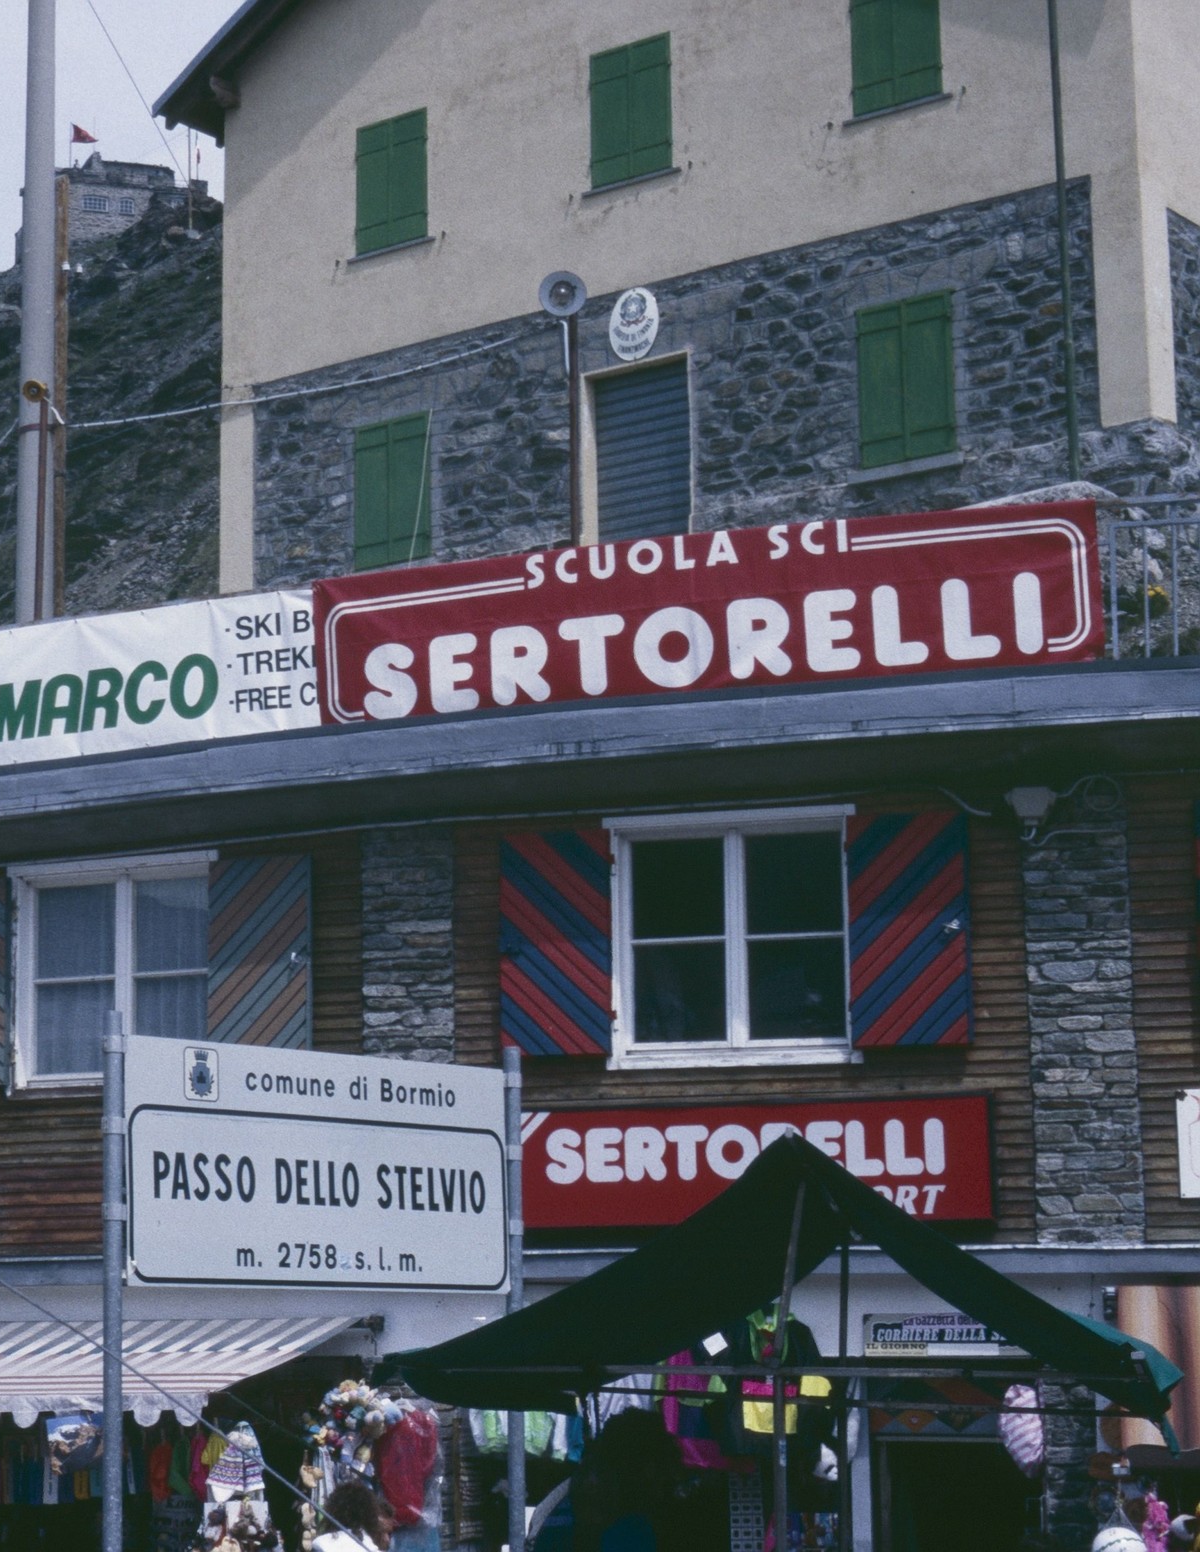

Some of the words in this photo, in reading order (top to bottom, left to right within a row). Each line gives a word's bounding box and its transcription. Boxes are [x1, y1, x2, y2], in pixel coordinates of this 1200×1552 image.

[525, 531, 739, 590] SCUOLA
[768, 519, 848, 556] SCI
[235, 612, 282, 640] SKI
[293, 609, 313, 634] B
[236, 645, 317, 676] TREK
[363, 571, 1050, 720] SERTORELLI
[234, 685, 292, 713] FREE
[300, 681, 319, 706] C
[245, 1070, 336, 1098] comune
[349, 1076, 368, 1100] di
[380, 1078, 456, 1107] Bormio
[153, 1151, 256, 1203] PASSO
[275, 1158, 360, 1209] DELLO
[377, 1164, 486, 1215] STELVIO
[236, 1246, 263, 1268] m.
[278, 1243, 338, 1270] 2758
[877, 1328, 939, 1342] CORRIERE
[944, 1328, 986, 1341] DELLA
